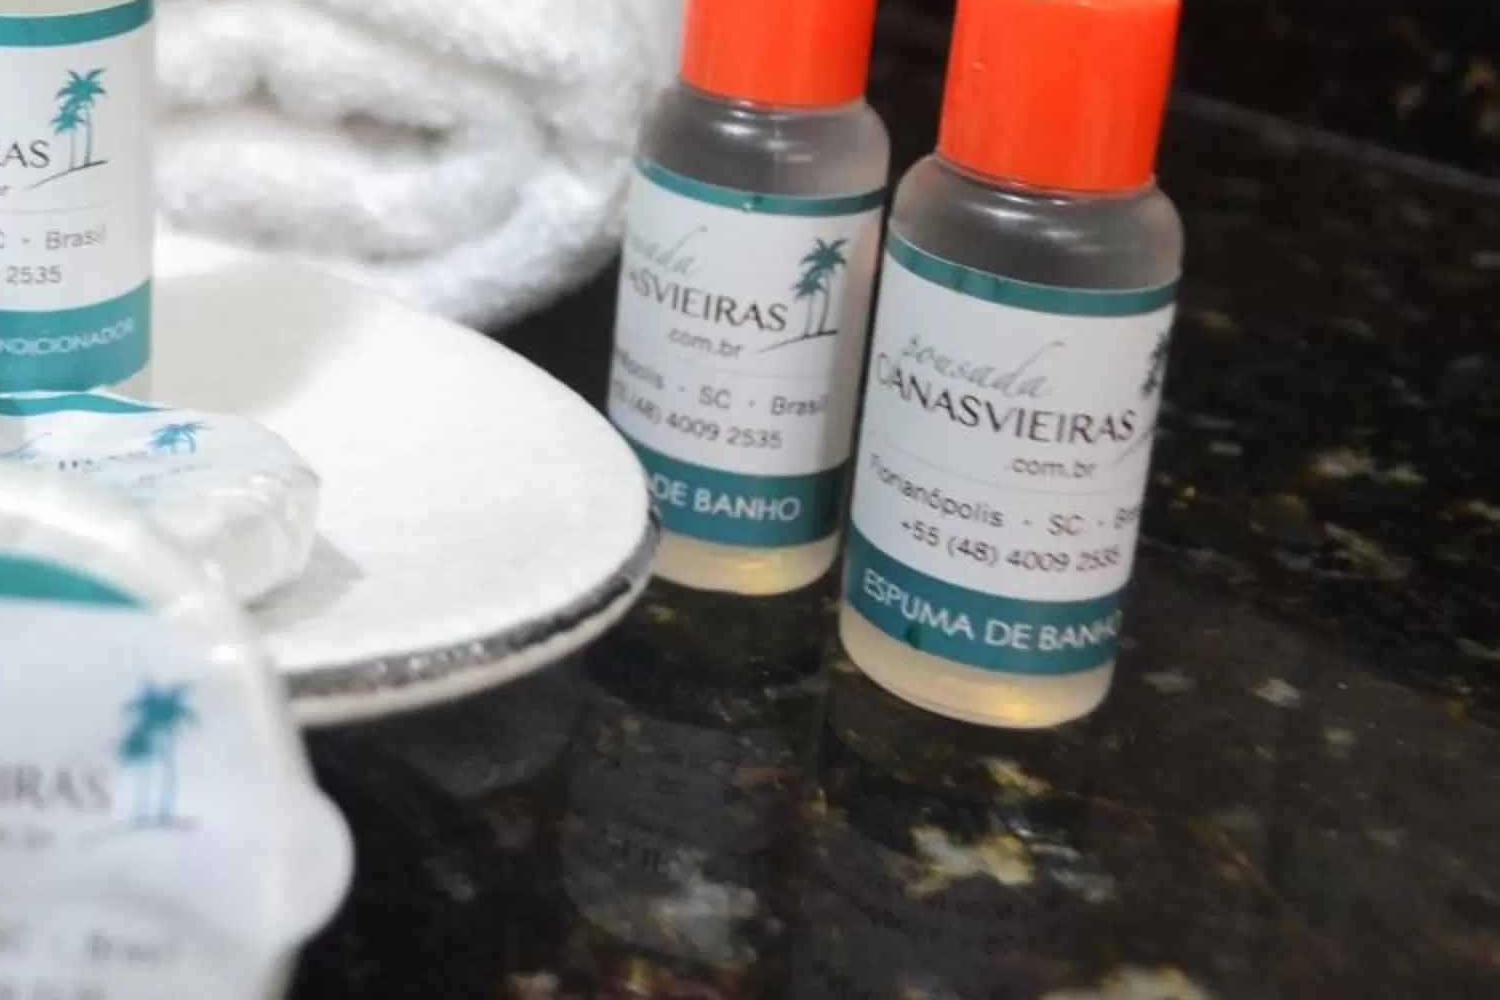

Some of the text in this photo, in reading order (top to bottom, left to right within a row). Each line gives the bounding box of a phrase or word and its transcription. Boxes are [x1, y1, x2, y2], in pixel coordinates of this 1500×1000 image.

[45, 224, 107, 250] Brasil
[5, 265, 62, 285] 2535
[627, 268, 788, 332] SVIEIRAS
[699, 385, 731, 410] SC
[876, 351, 1138, 445] CANASVIEIRAS
[666, 412, 719, 442] 4009
[726, 426, 784, 450] 2535
[652, 473, 801, 521] DE BANHO
[900, 519, 939, 547] +55
[948, 534, 999, 567] (48)
[1007, 549, 1070, 573] 4009
[1048, 514, 1085, 537] SC
[863, 568, 976, 641] ESPUMA
[985, 619, 1032, 651] DE
